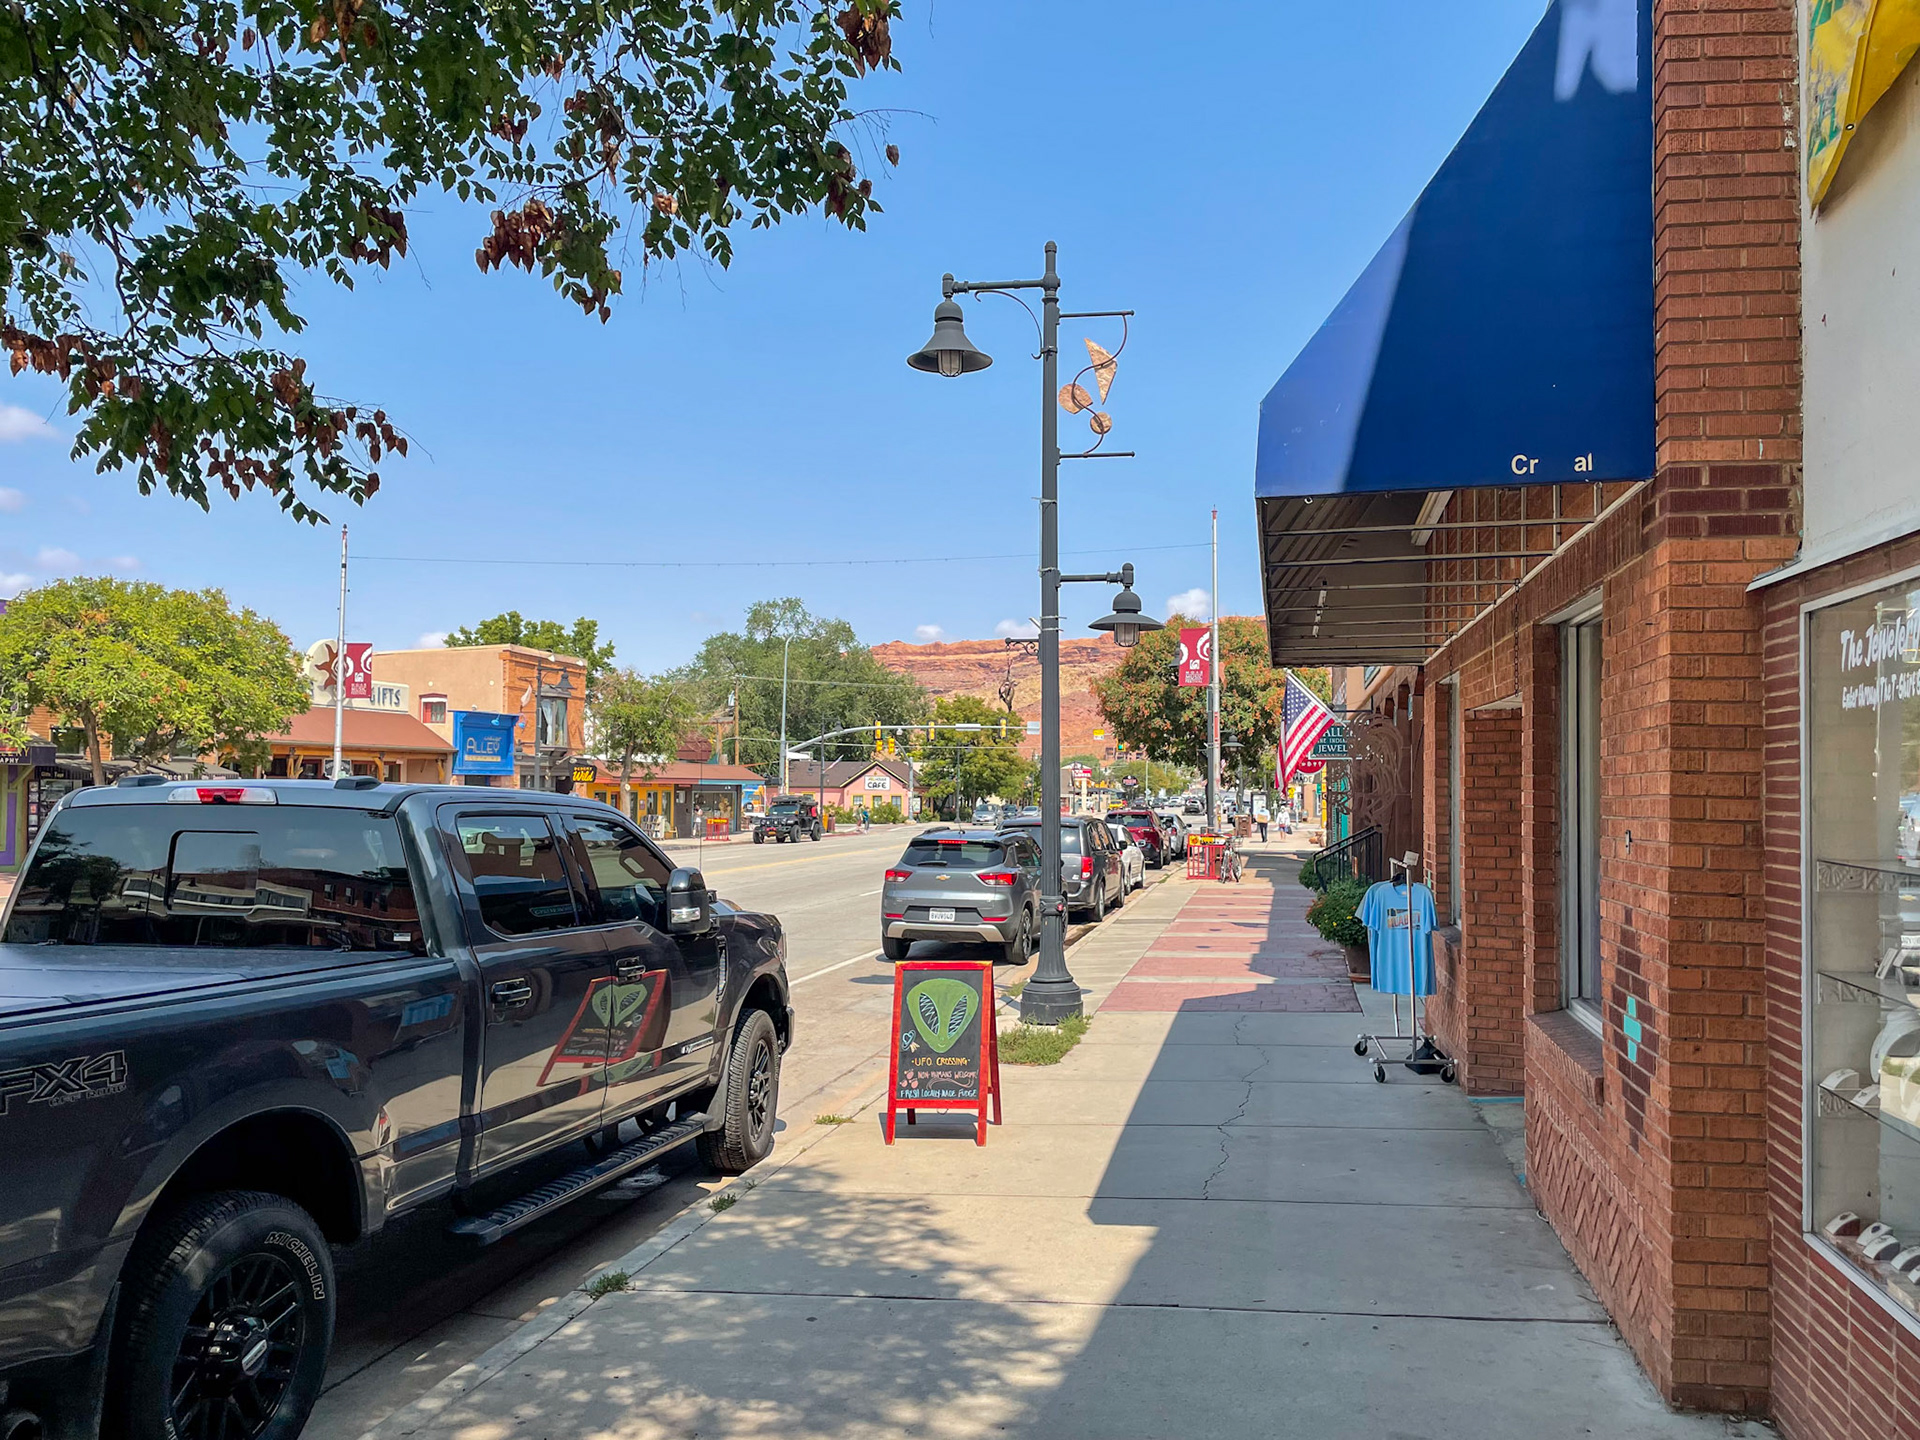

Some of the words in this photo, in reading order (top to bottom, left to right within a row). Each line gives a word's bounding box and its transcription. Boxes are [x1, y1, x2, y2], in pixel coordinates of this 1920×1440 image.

[1840, 629, 1864, 673] The
[466, 737, 500, 754] ALLEY
[1318, 744, 1348, 753] JEWEL
[573, 770, 594, 782] Wild
[867, 781, 887, 789] CAFE
[914, 1057, 932, 1066] UFO
[936, 1057, 968, 1067] CROSSING
[0, 1049, 128, 1116] FX4
[900, 1089, 920, 1099] FRESH
[958, 1089, 977, 1098] FUDGE
[264, 1231, 326, 1300] MICHELIN
